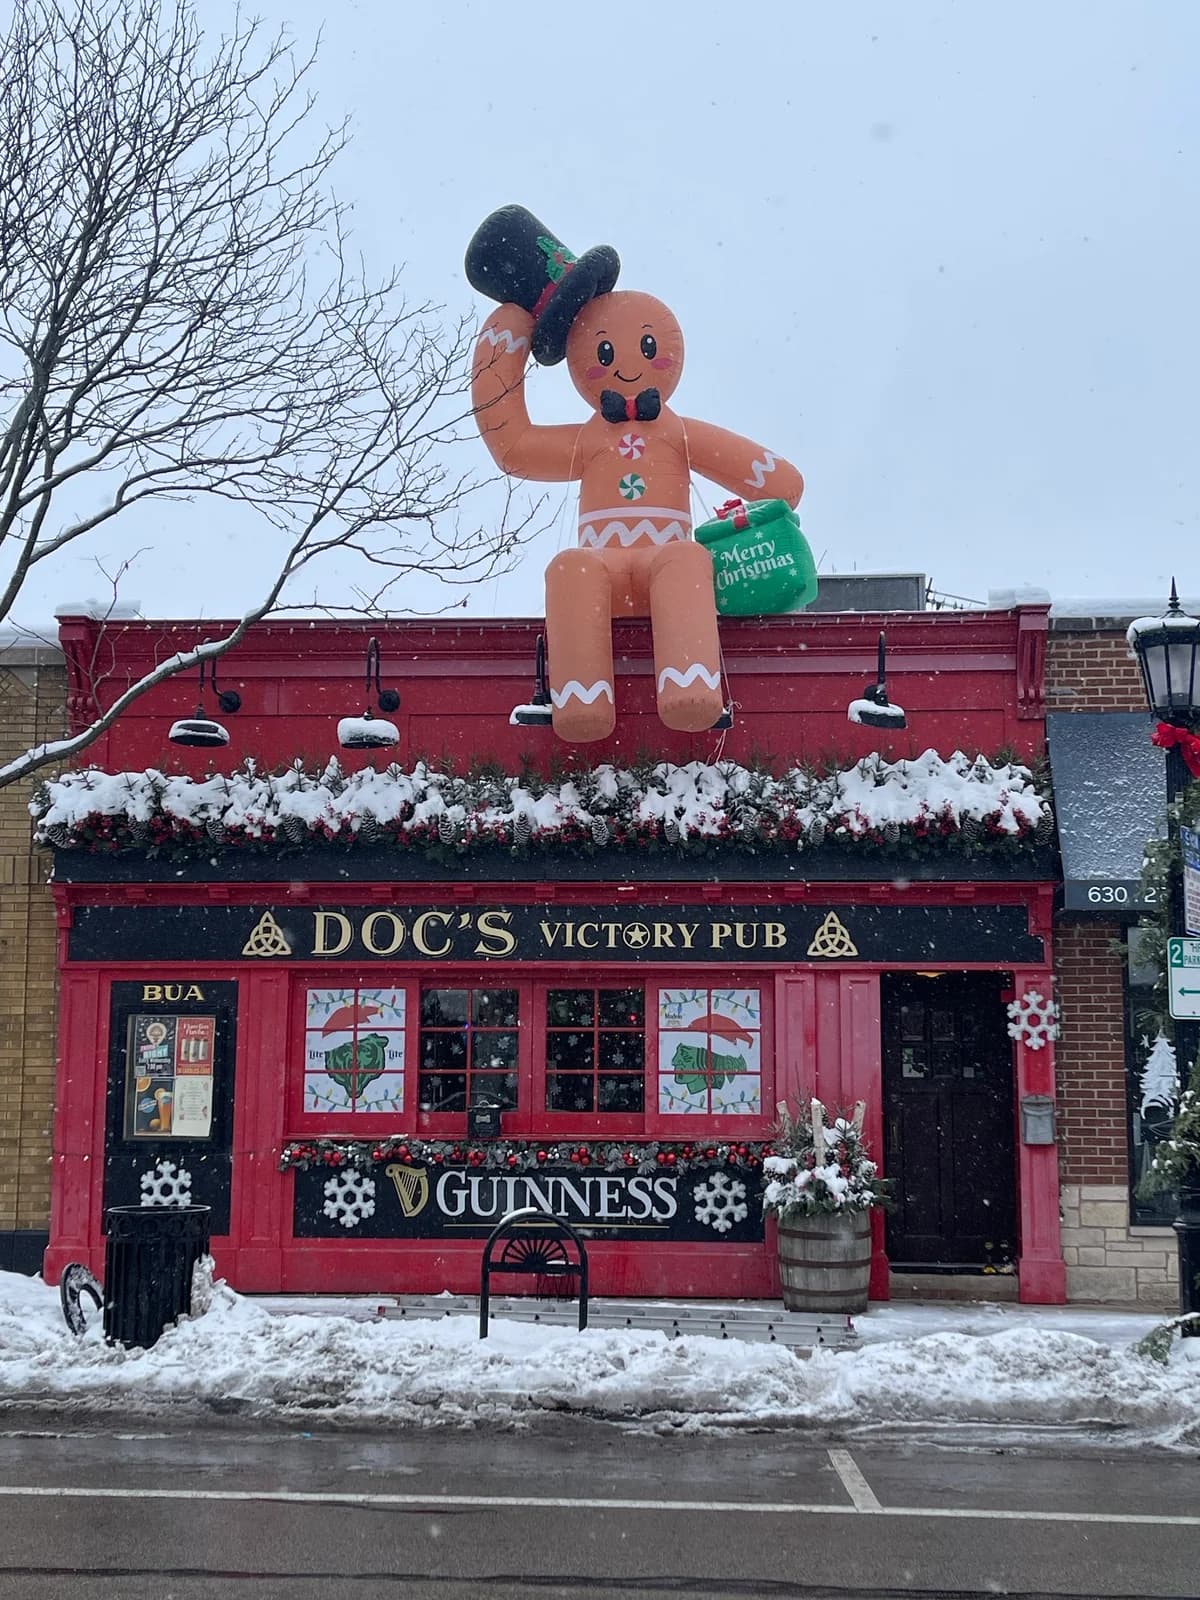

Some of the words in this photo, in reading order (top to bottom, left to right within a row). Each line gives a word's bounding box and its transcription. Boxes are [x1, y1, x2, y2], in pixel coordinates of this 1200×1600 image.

[720, 539, 775, 568] Merry
[716, 553, 794, 590] Christmas
[310, 911, 518, 957] DOC'S
[710, 922, 787, 949] PUB
[1171, 944, 1182, 964] 2
[142, 984, 205, 1002] BUA
[436, 1170, 678, 1219] GUINNESS
